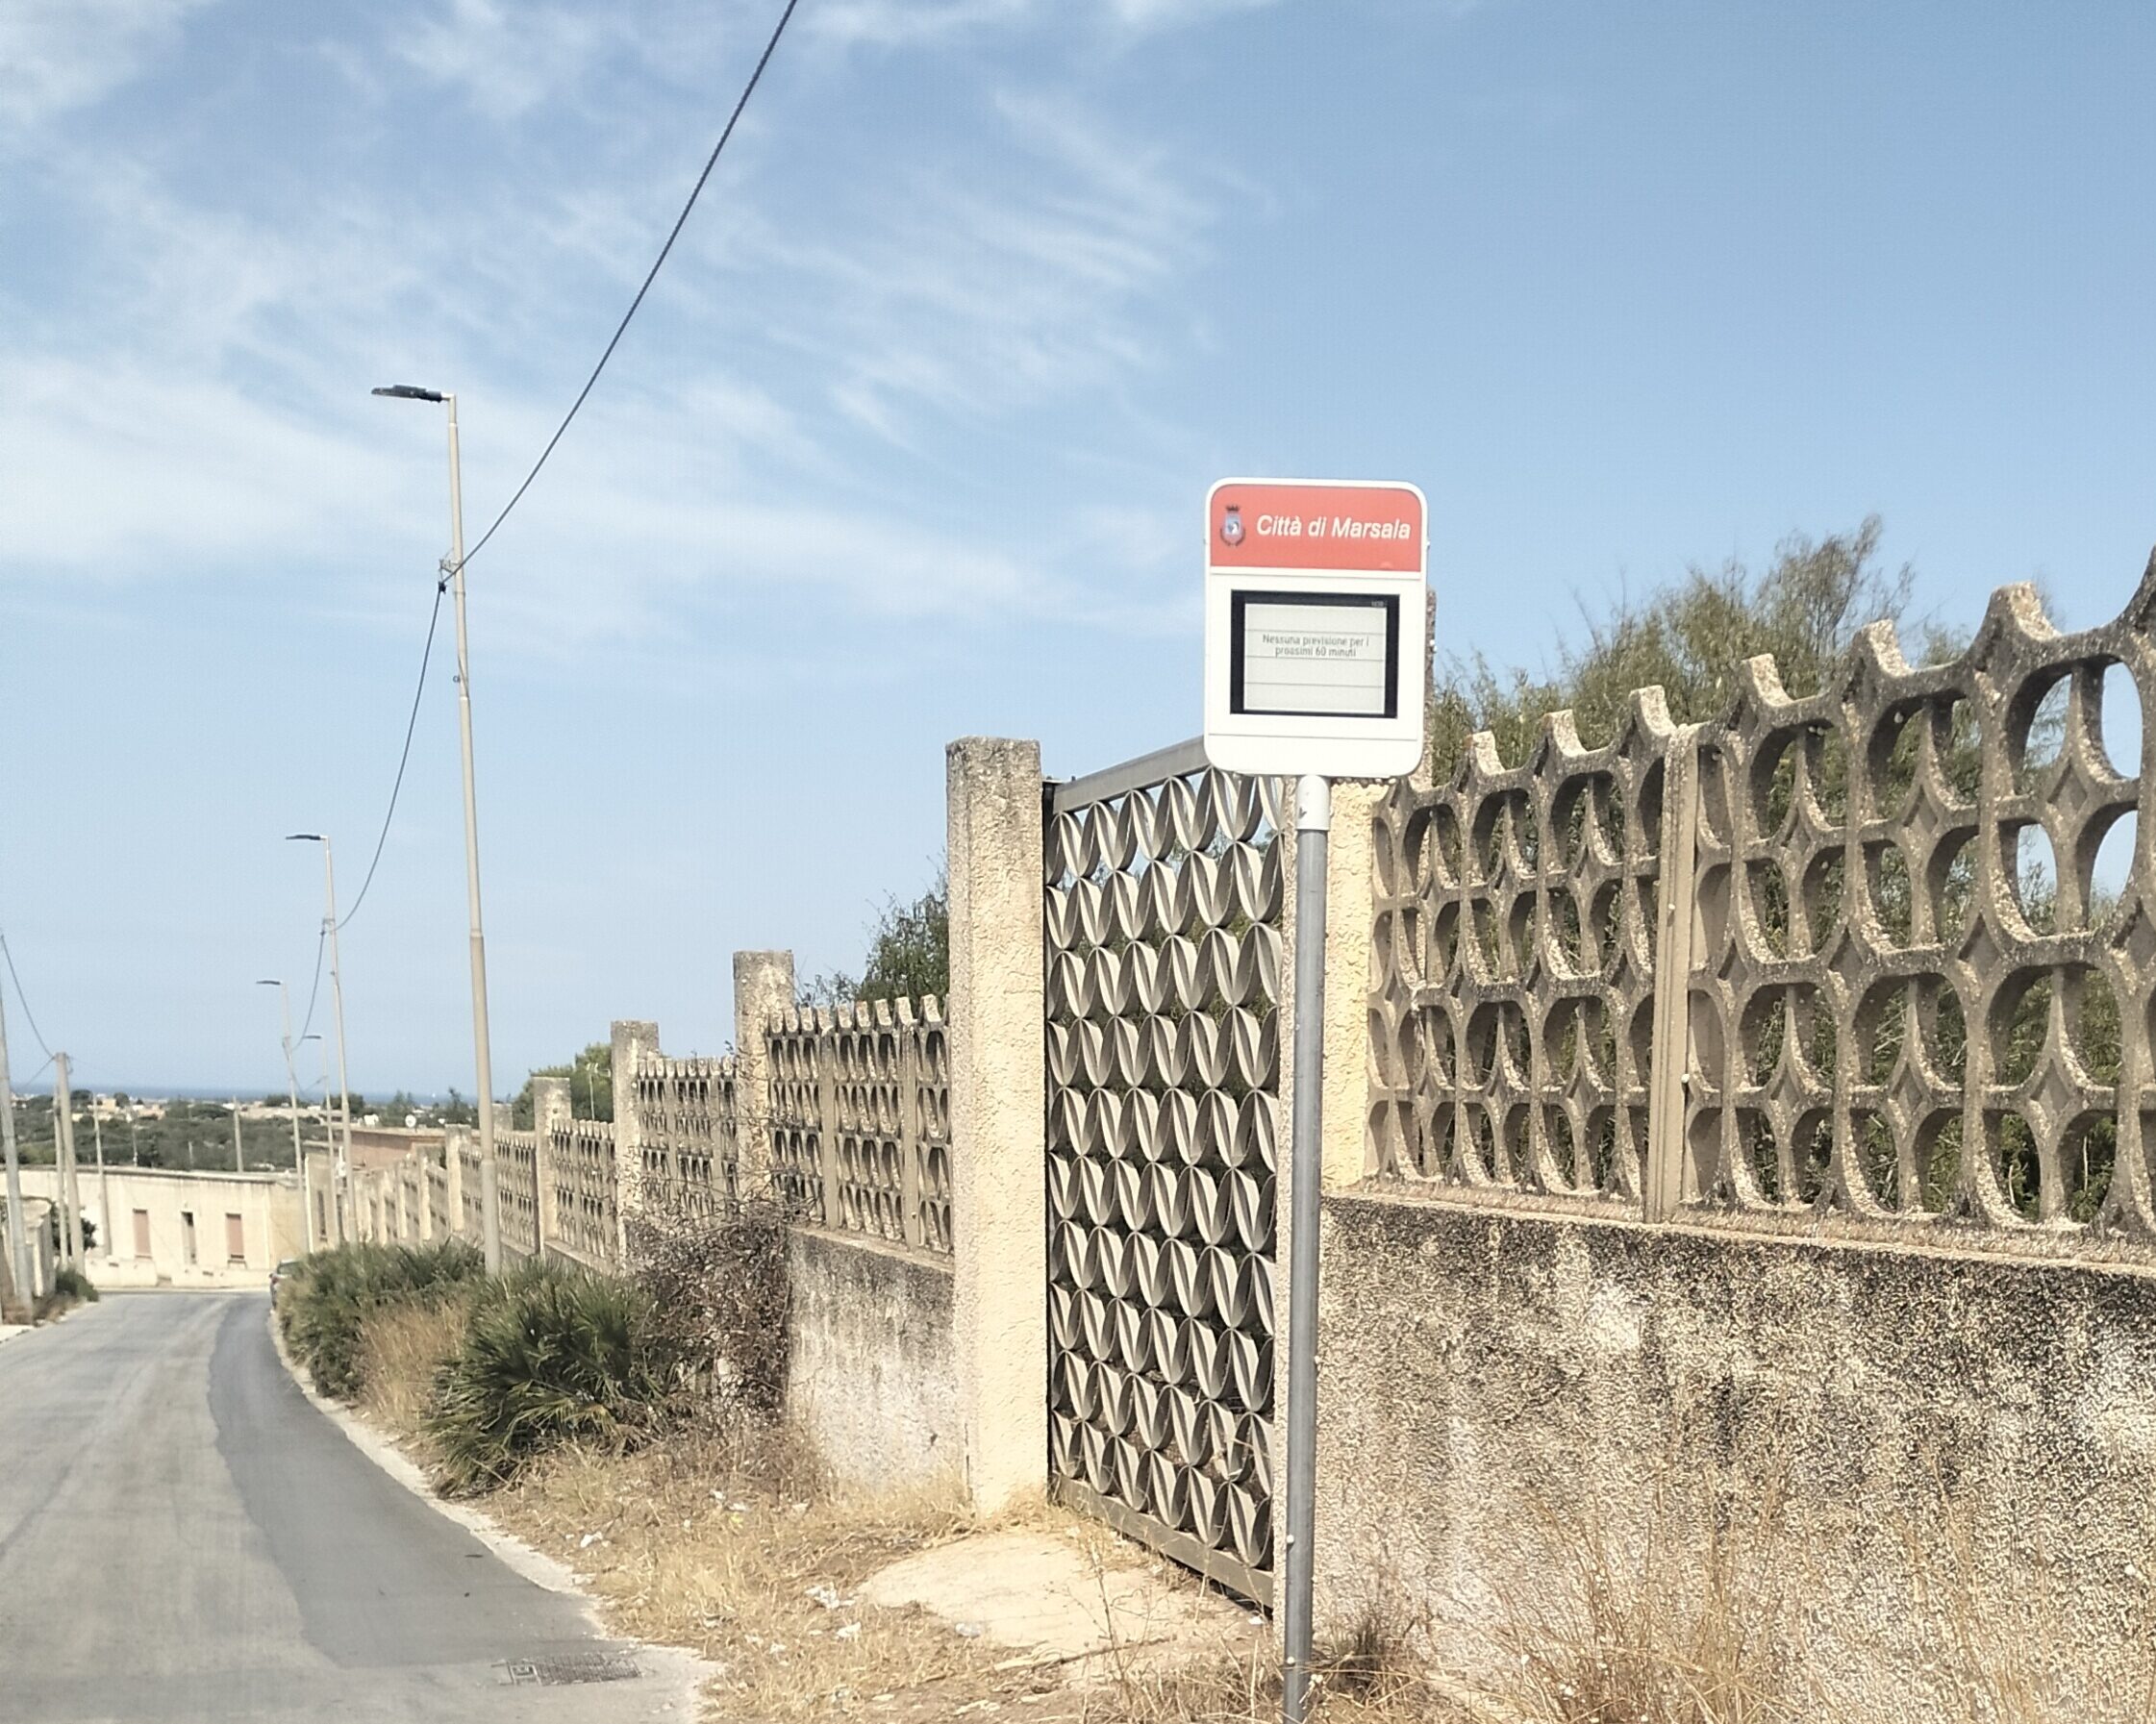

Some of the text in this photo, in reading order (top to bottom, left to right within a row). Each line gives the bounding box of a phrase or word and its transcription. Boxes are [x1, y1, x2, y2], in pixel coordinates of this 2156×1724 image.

[1257, 514, 1411, 539] Città di Marsala
[1262, 634, 1300, 644] Nessuna
[1302, 636, 1347, 647] previsione
[1349, 638, 1364, 648] per
[1316, 646, 1326, 657] 60
[1329, 648, 1356, 658] minuti
